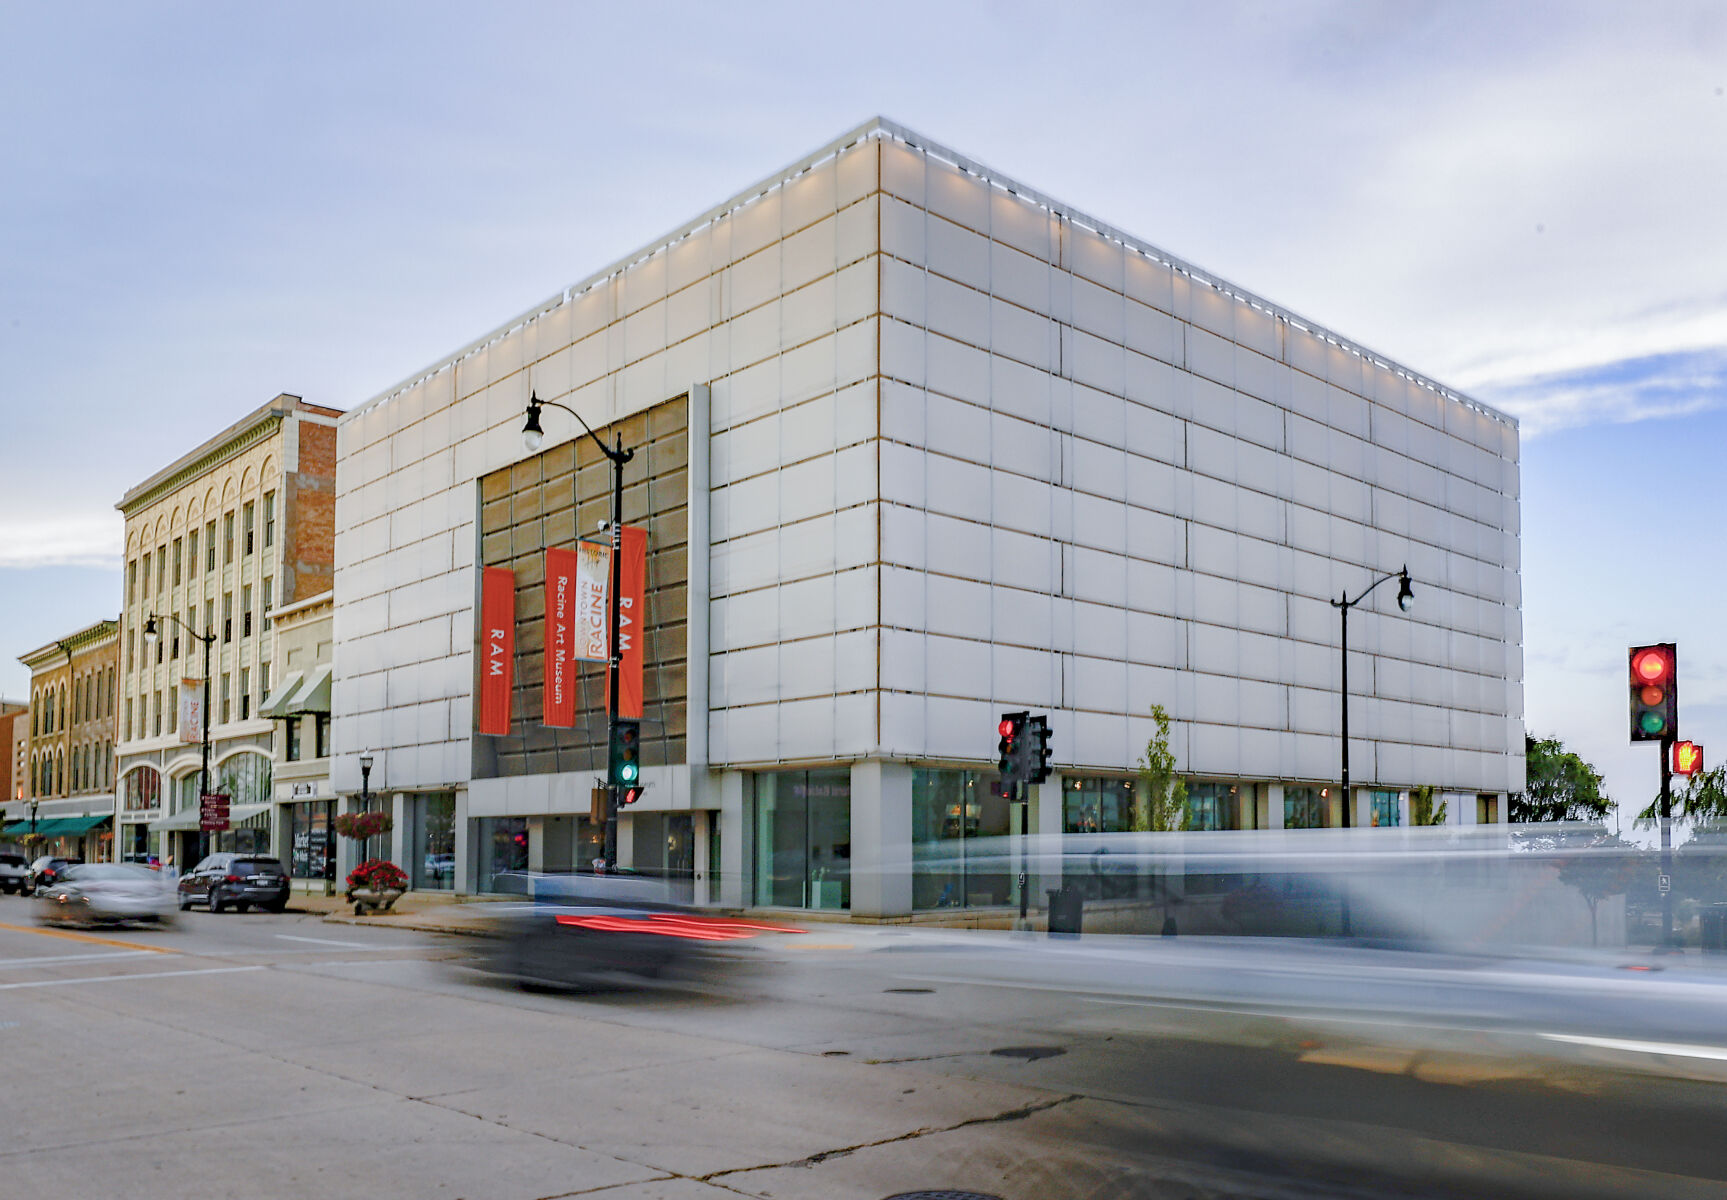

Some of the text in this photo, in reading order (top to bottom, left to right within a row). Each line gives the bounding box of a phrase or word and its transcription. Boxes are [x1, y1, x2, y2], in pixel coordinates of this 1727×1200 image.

[555, 576, 568, 704] Racine Art Museum
[590, 583, 603, 655] RACINE
[619, 597, 633, 651] RAM
[489, 628, 505, 676] RAM
